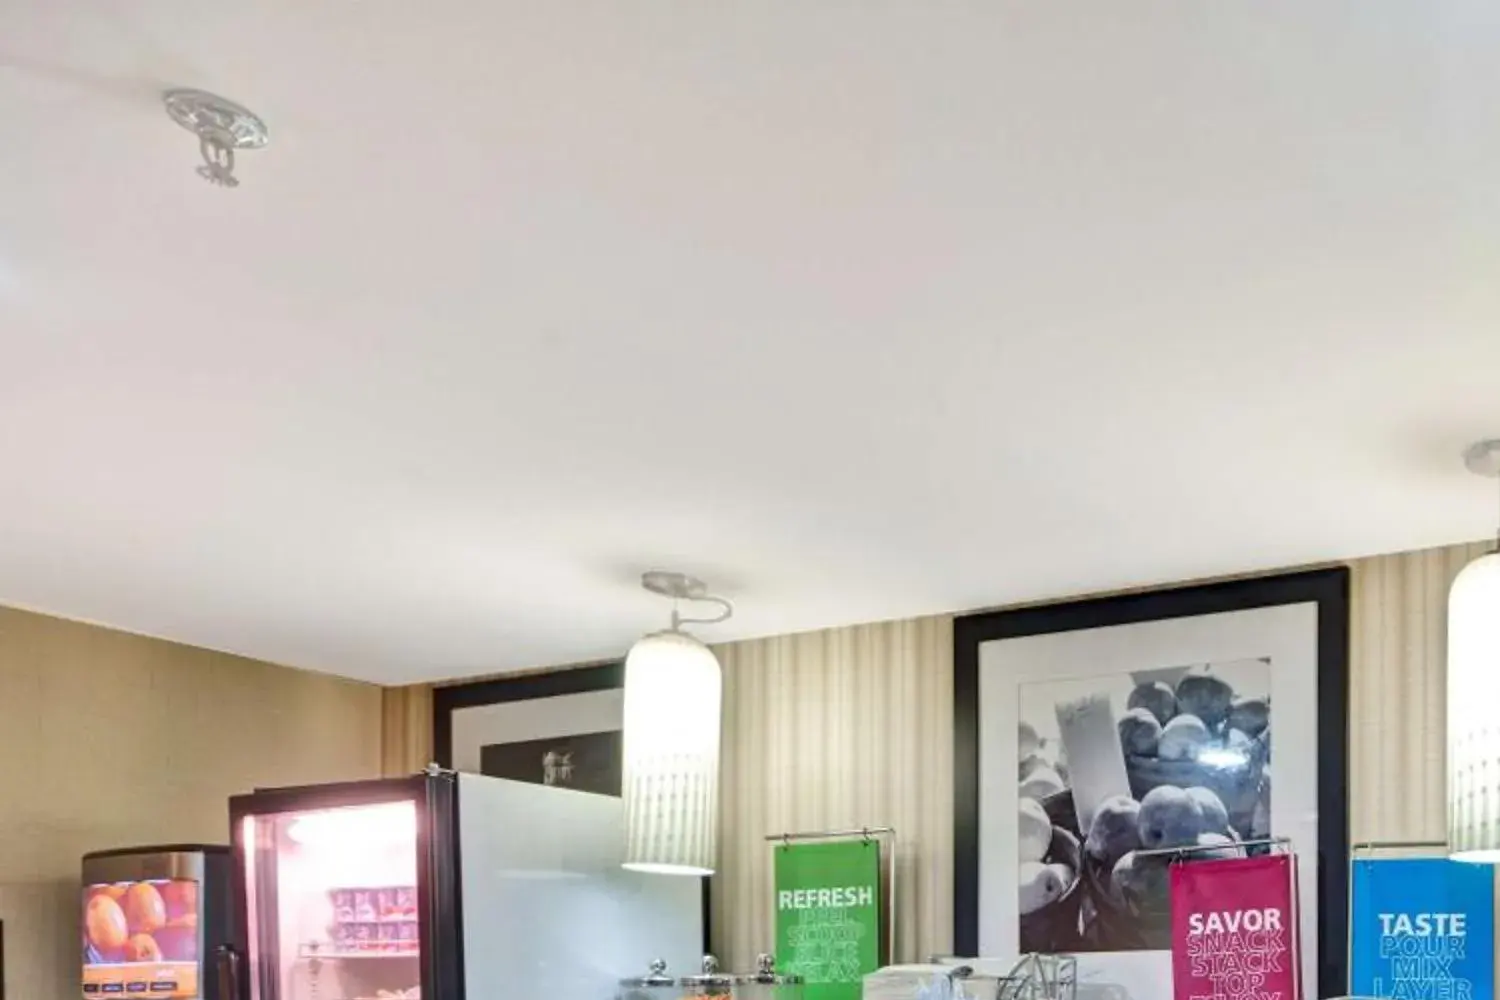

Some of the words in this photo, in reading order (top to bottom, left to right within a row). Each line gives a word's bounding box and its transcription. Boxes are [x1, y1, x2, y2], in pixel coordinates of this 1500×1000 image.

[778, 885, 873, 910] REFRESH
[1188, 908, 1282, 935] SAVOR
[1378, 912, 1467, 937] TASTE
[1186, 929, 1286, 957] SNACK
[1380, 934, 1466, 959] POUR
[1191, 949, 1282, 977] STACK
[1391, 956, 1453, 980] MIX
[1209, 971, 1265, 996] TOP
